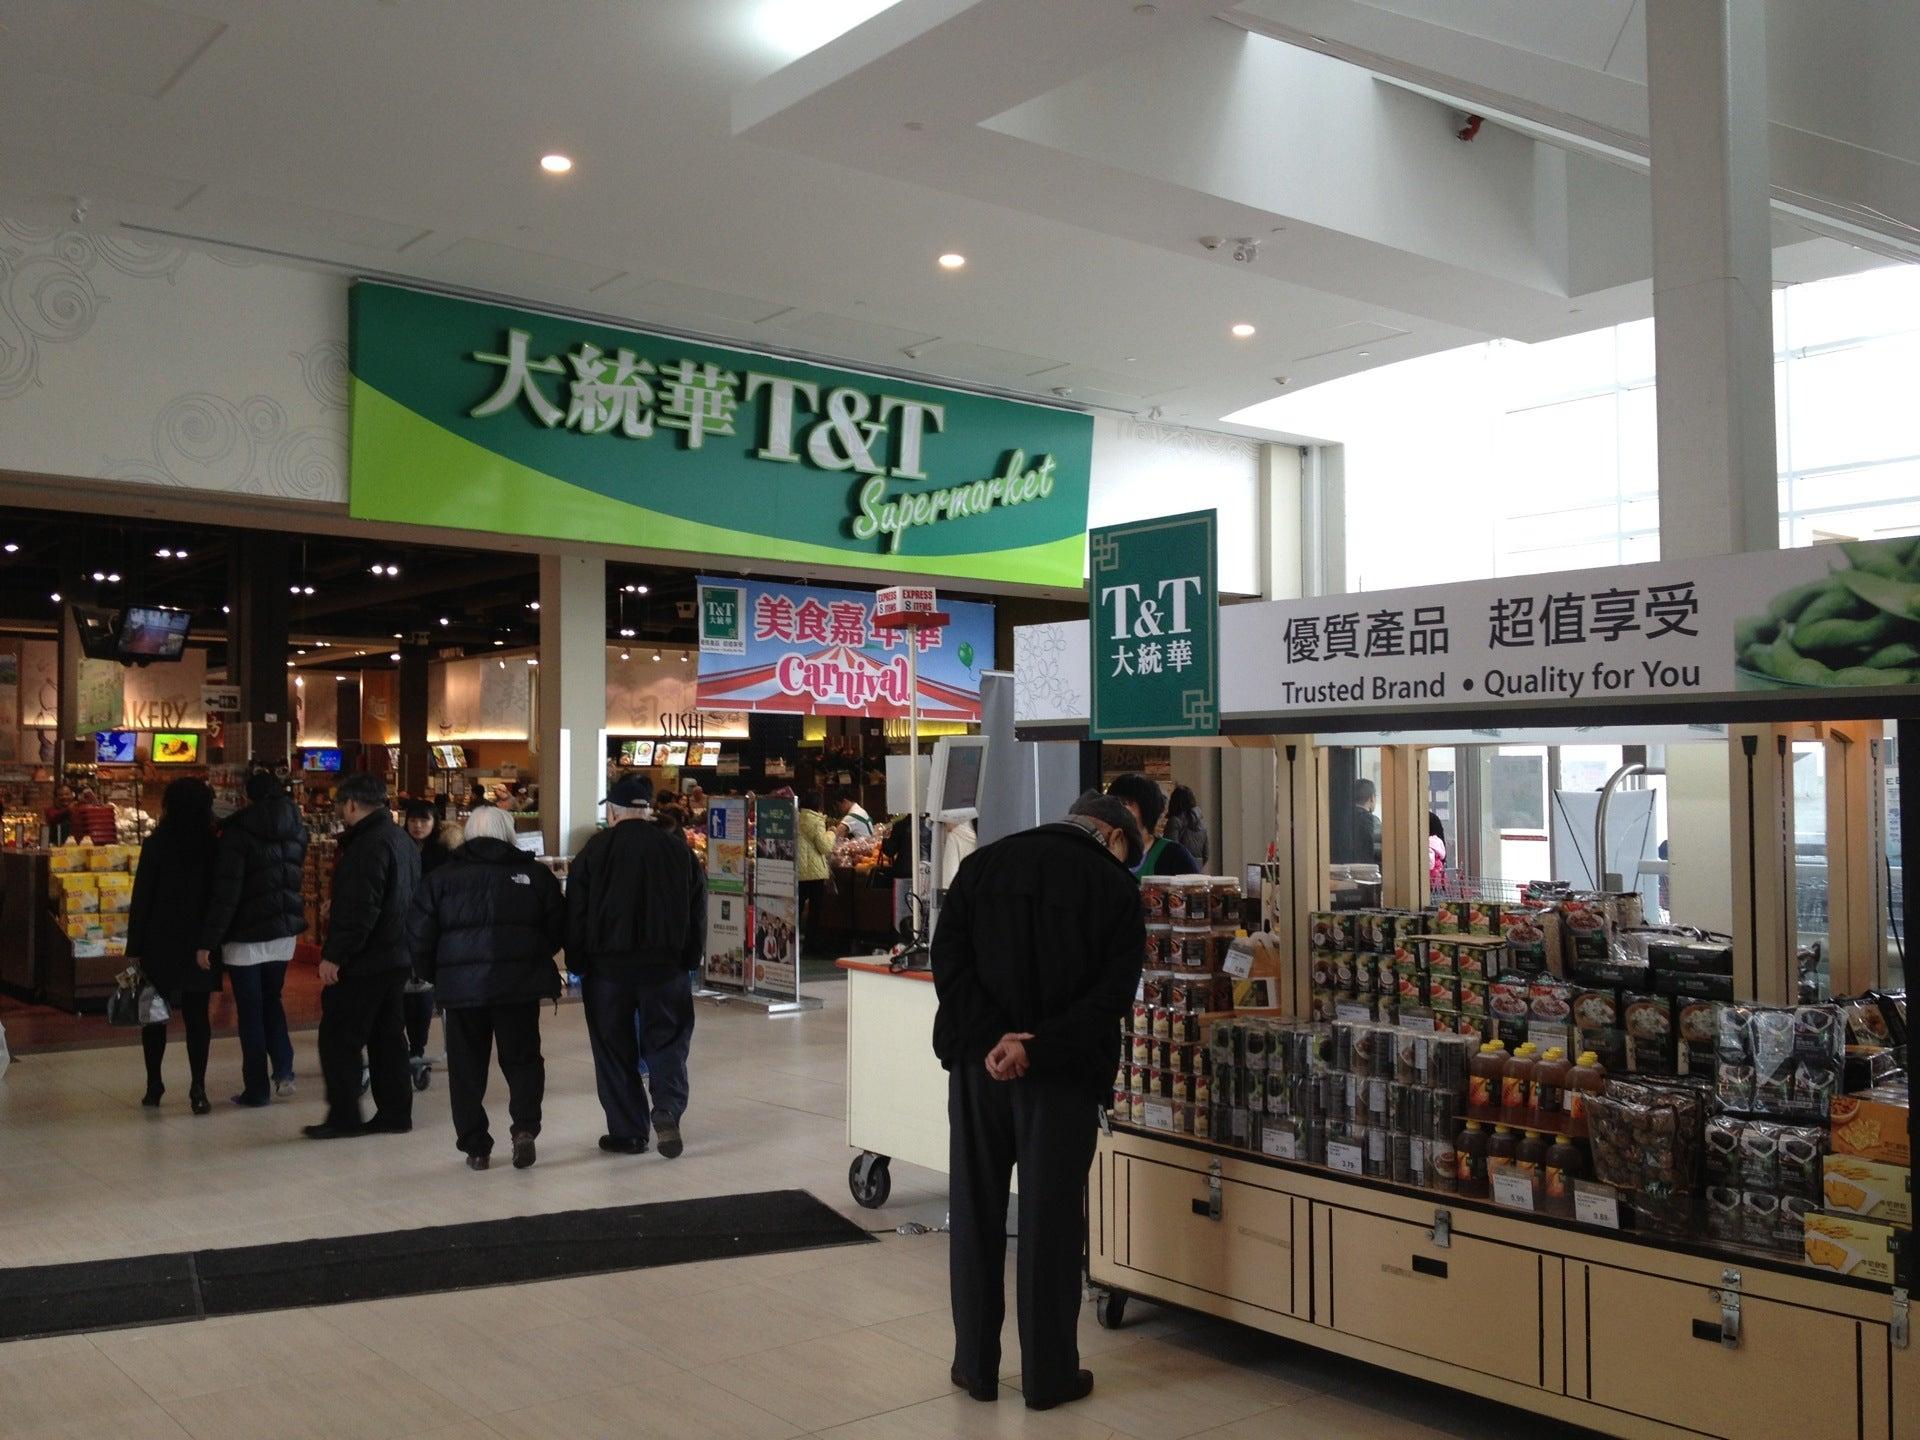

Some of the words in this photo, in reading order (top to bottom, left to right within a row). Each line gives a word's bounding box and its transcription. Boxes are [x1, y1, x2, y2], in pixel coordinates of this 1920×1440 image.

[470, 328, 741, 450] 大統華
[745, 369, 945, 480] T&T
[852, 449, 1056, 554] Supermarket
[706, 601, 735, 617] T&T
[902, 589, 933, 600] EXPRESS
[905, 600, 912, 611] 8
[913, 602, 932, 611] ITEMS
[1101, 575, 1201, 640] T&T
[1282, 605, 1449, 665] 優質產品
[1488, 581, 1699, 651] 超值享受
[779, 655, 911, 706] Carnival
[1110, 639, 1193, 678] 大統華
[1282, 676, 1365, 704] Trusted
[1372, 671, 1445, 700] Brand
[1484, 666, 1585, 698] Quality
[1592, 661, 1635, 691] for
[1641, 659, 1700, 688] You
[660, 712, 704, 738] SUSHI
